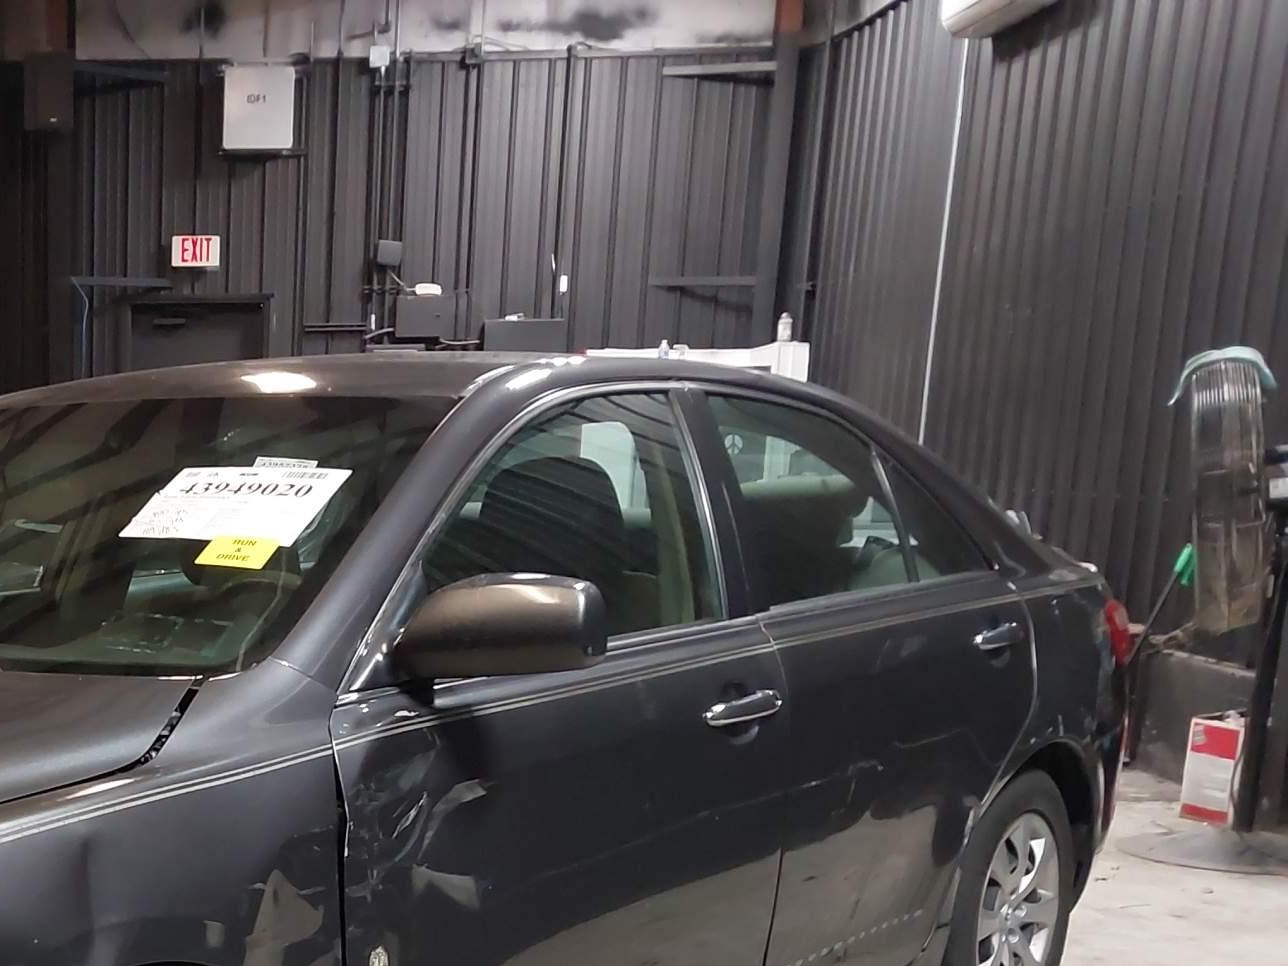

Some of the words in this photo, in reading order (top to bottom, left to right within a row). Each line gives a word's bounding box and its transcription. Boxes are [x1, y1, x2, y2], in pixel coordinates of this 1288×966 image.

[181, 237, 212, 262] EXIT
[179, 482, 313, 497] 43949020
[215, 553, 250, 561] DRIVE
